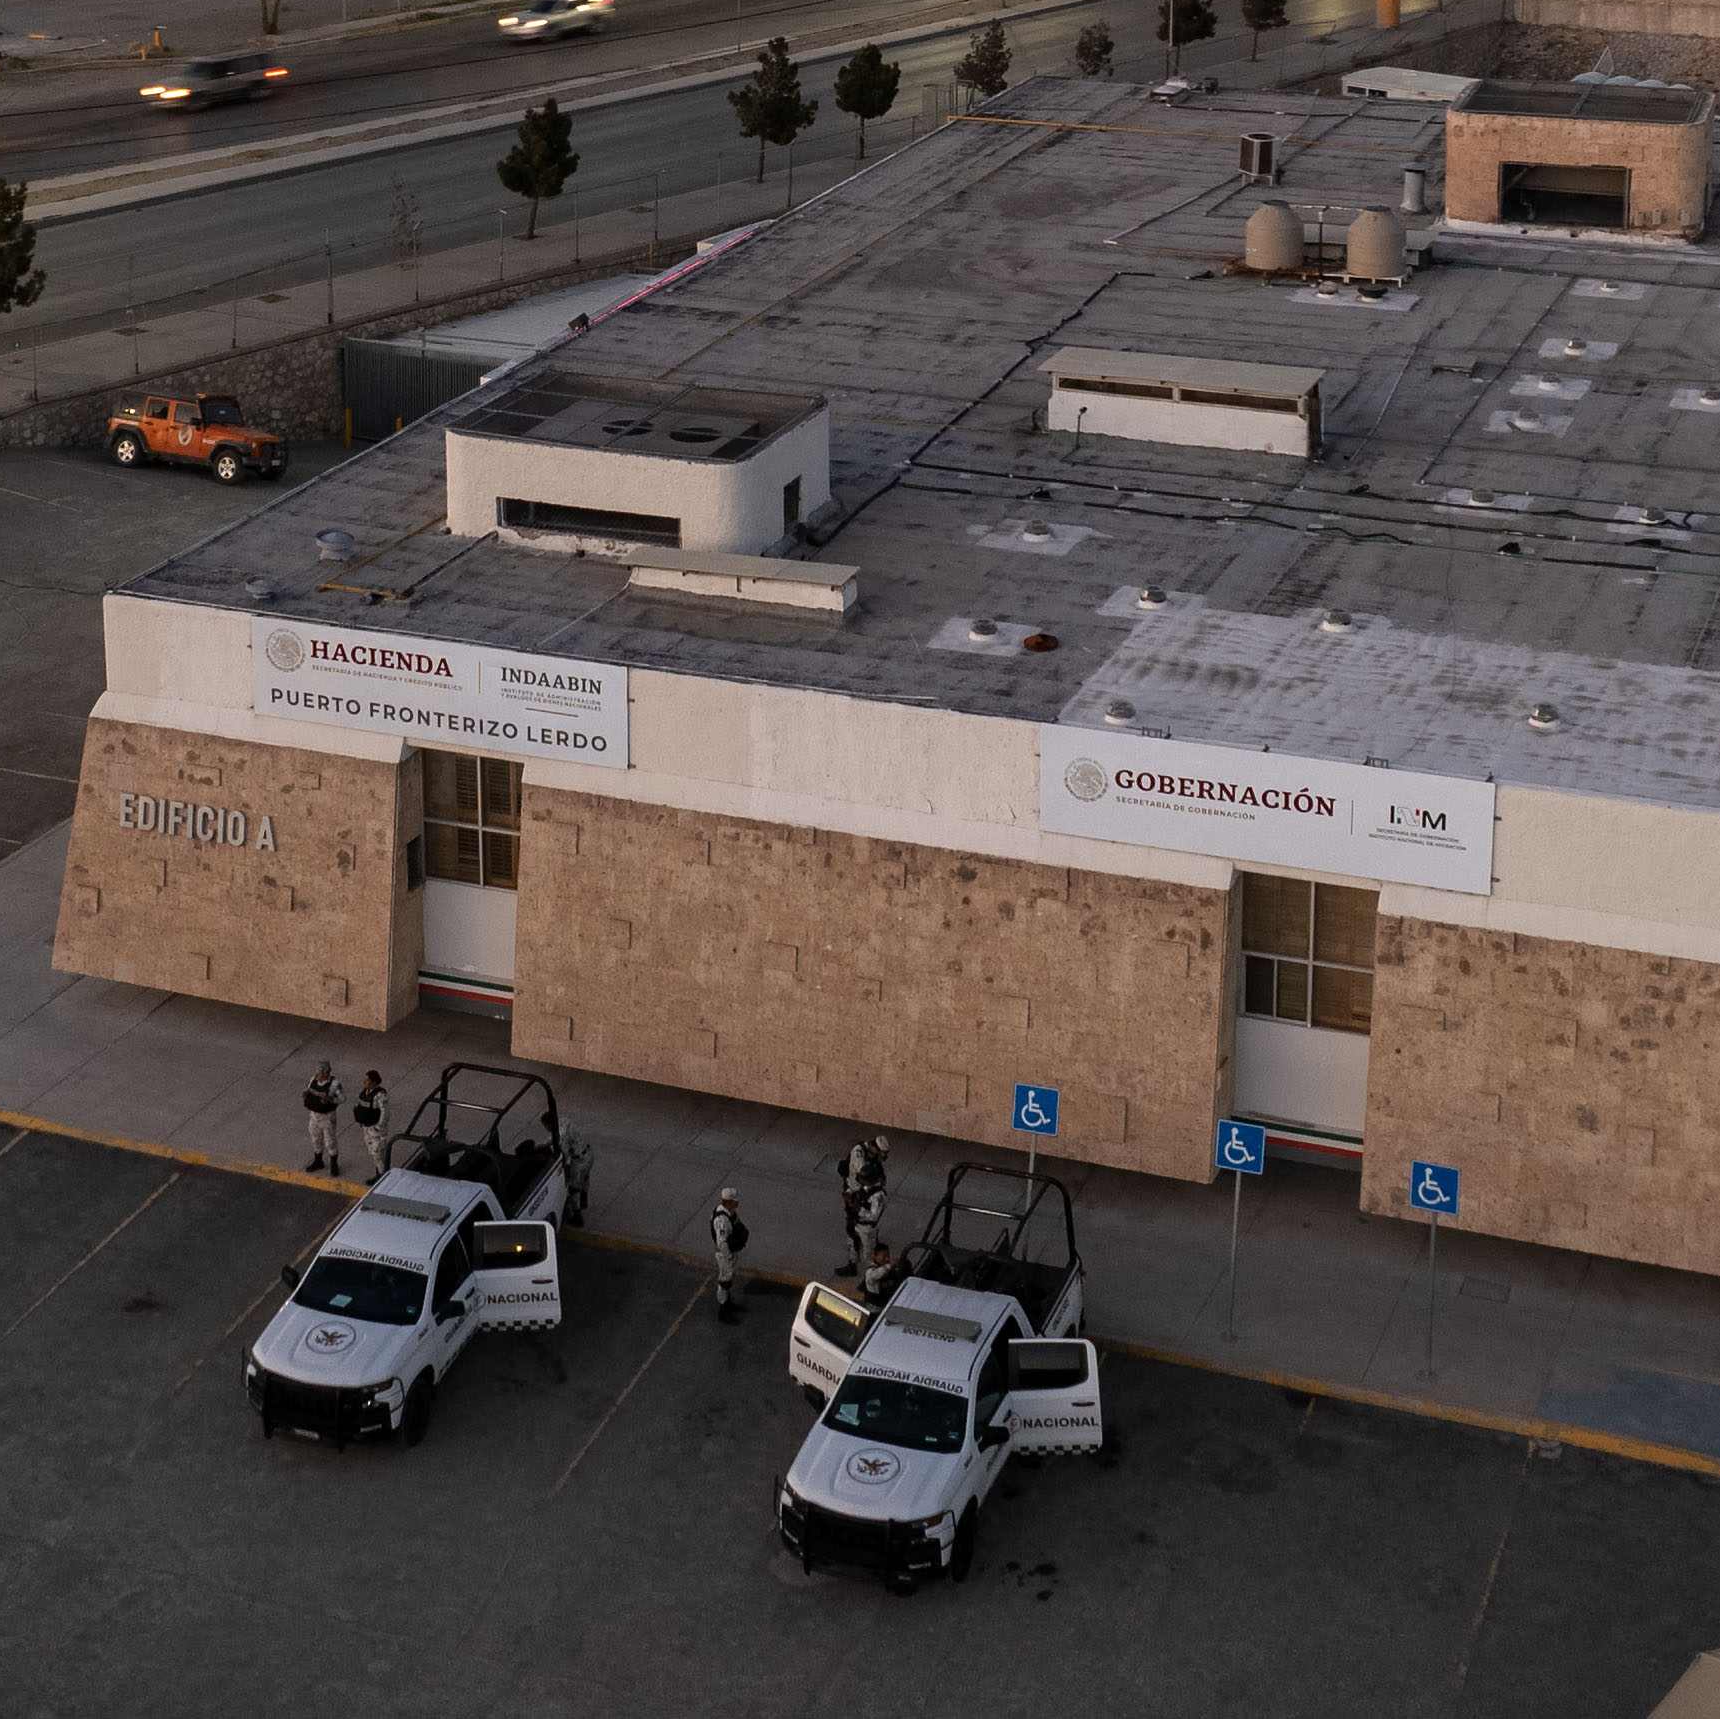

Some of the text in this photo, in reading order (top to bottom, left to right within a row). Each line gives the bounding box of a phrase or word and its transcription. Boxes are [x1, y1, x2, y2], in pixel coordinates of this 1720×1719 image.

[310, 639, 453, 677] HACIENDA
[501, 666, 602, 695] INDAABIN
[271, 687, 607, 751] PUERTO FRONTERIZO LERDO
[1114, 769, 1336, 817] GOBERNACIÓN
[1173, 804, 1186, 813] DE
[119, 792, 276, 852] EDIFICIO A
[487, 1293, 559, 1305] NACIONAL
[1023, 1416, 1099, 1429] NACIONAL
